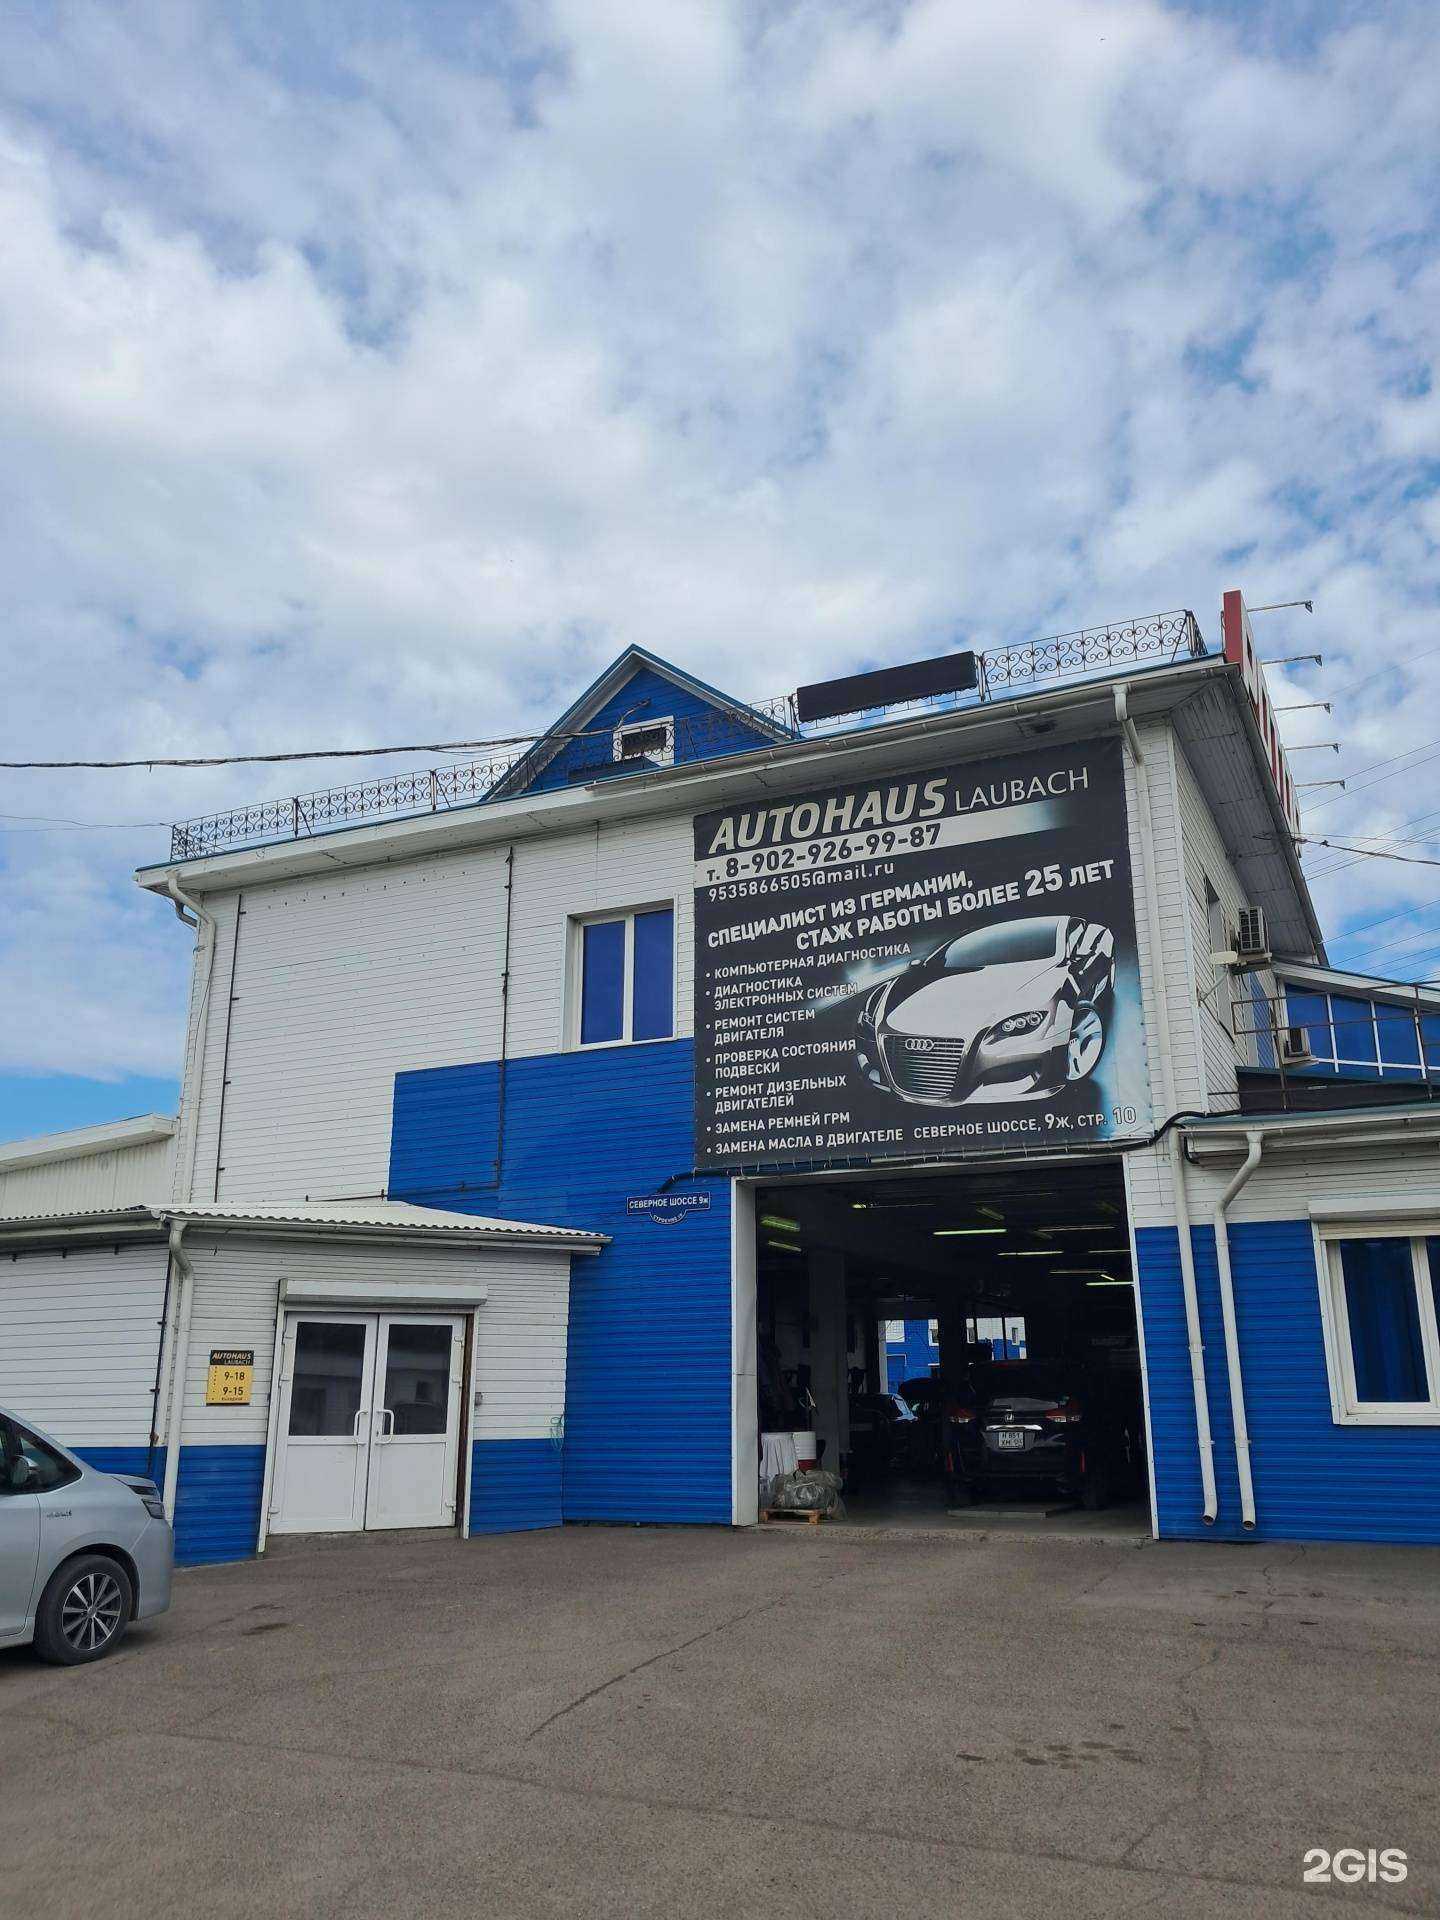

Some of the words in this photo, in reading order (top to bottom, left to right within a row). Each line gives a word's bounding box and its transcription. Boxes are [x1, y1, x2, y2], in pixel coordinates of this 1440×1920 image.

[709, 778, 948, 854] AUTOHAUS
[954, 767, 1090, 812] LAUBACH
[725, 822, 943, 879] 8-902-926-99-87
[708, 860, 895, 902] 9535866505@mail.ru
[707, 905, 827, 949] СПЕЦИАЛИСТ
[831, 896, 856, 918] ИЗ
[860, 870, 974, 912] ГЕРМАНИИ,
[796, 920, 852, 951] СТАЖ
[857, 903, 944, 938] РАБОТЫ
[947, 881, 1021, 915] БОЛЕЕ
[1024, 863, 1064, 897] 25
[1068, 859, 1116, 888] ЛЕТ
[714, 956, 814, 979] КОМПЬЮТЕРНАЯ
[817, 942, 912, 967] ДИАГНОСТИКА
[714, 976, 803, 999] ДИАГНОСТИКА
[714, 990, 805, 1011] ЭЛЕКТРОННЫХ
[807, 982, 858, 999] СИСТЕМ
[714, 1014, 762, 1031] РЕМОНТ
[765, 1008, 816, 1025] СИСТЕМ
[714, 1026, 784, 1046] ДВИГАТЕЛЯ
[714, 1048, 779, 1065] ПРОВЕРКА
[781, 1039, 857, 1057] СОСТОЯНИЯ
[714, 1061, 780, 1079] ПОДВЕСКИ
[715, 1083, 764, 1099] РЕМОНТ
[766, 1075, 847, 1093] ДИЗЕЛЬНЫХ
[714, 1094, 794, 1115] ДВИГАТЕЛЕЙ
[715, 1119, 766, 1134] ЗАМЕНА
[768, 1112, 821, 1130] РЕМНЕЙ
[824, 1111, 850, 1125] ГРМ
[913, 1121, 984, 1139] СЕВЕРНОЕ
[987, 1118, 1042, 1134] ШОССЕ,
[1077, 1113, 1108, 1127] СТР.
[1112, 1106, 1137, 1124] 10
[715, 1140, 766, 1155] ЗАМЕНА
[768, 1134, 812, 1150] МАСЛА
[815, 1134, 824, 1146] В
[826, 1128, 904, 1148] ДВИГАТЕЛЕ
[629, 1199, 667, 1209] СЕВЕРНОЕ
[669, 1197, 697, 1206] ШОССЕ
[211, 1352, 252, 1360] AUTOHAUS
[224, 1371, 245, 1380] 9-18
[222, 1386, 244, 1395] 9-15
